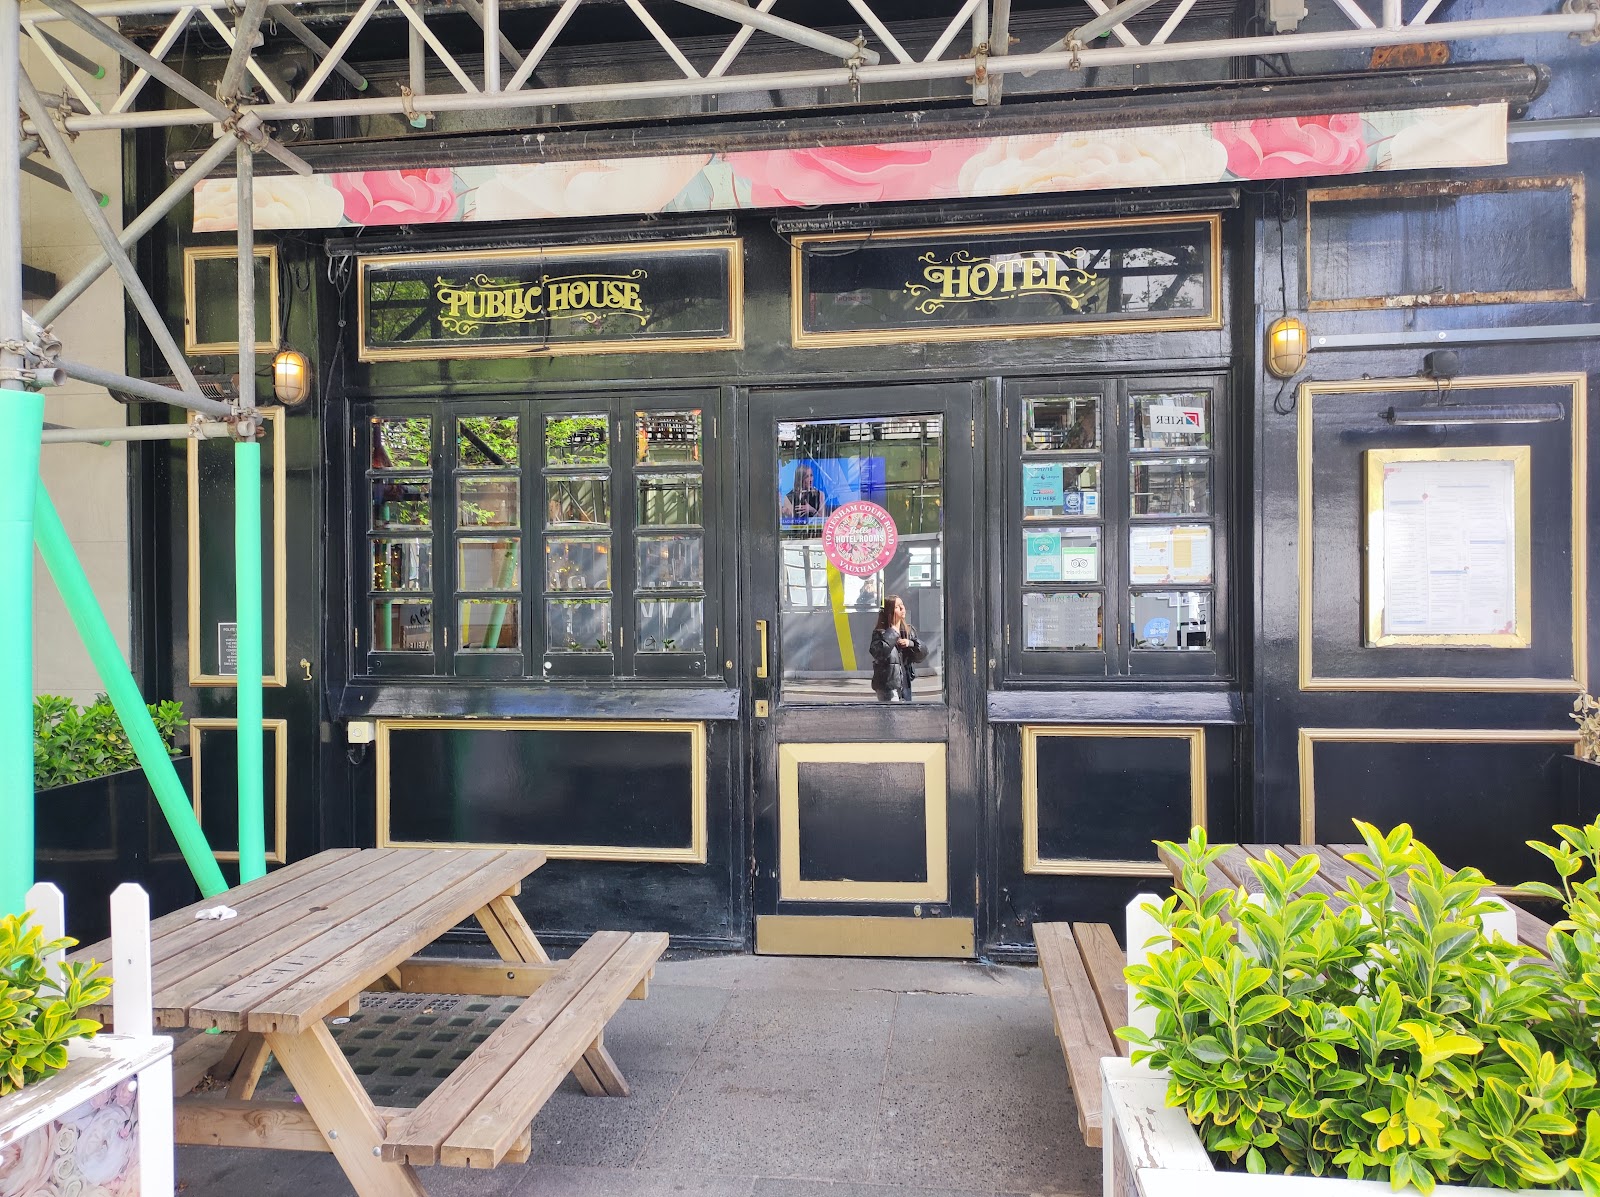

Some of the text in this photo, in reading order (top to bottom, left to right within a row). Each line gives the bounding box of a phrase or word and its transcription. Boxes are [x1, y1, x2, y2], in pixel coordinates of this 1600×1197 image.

[923, 257, 1070, 298] HOTEL
[436, 280, 643, 318] PUBLIC HOUSE
[825, 504, 895, 545] TOTTENHAM COURT ROAD
[835, 534, 884, 543] HOTEL ROOMS
[839, 560, 882, 573] VAUXHALL
